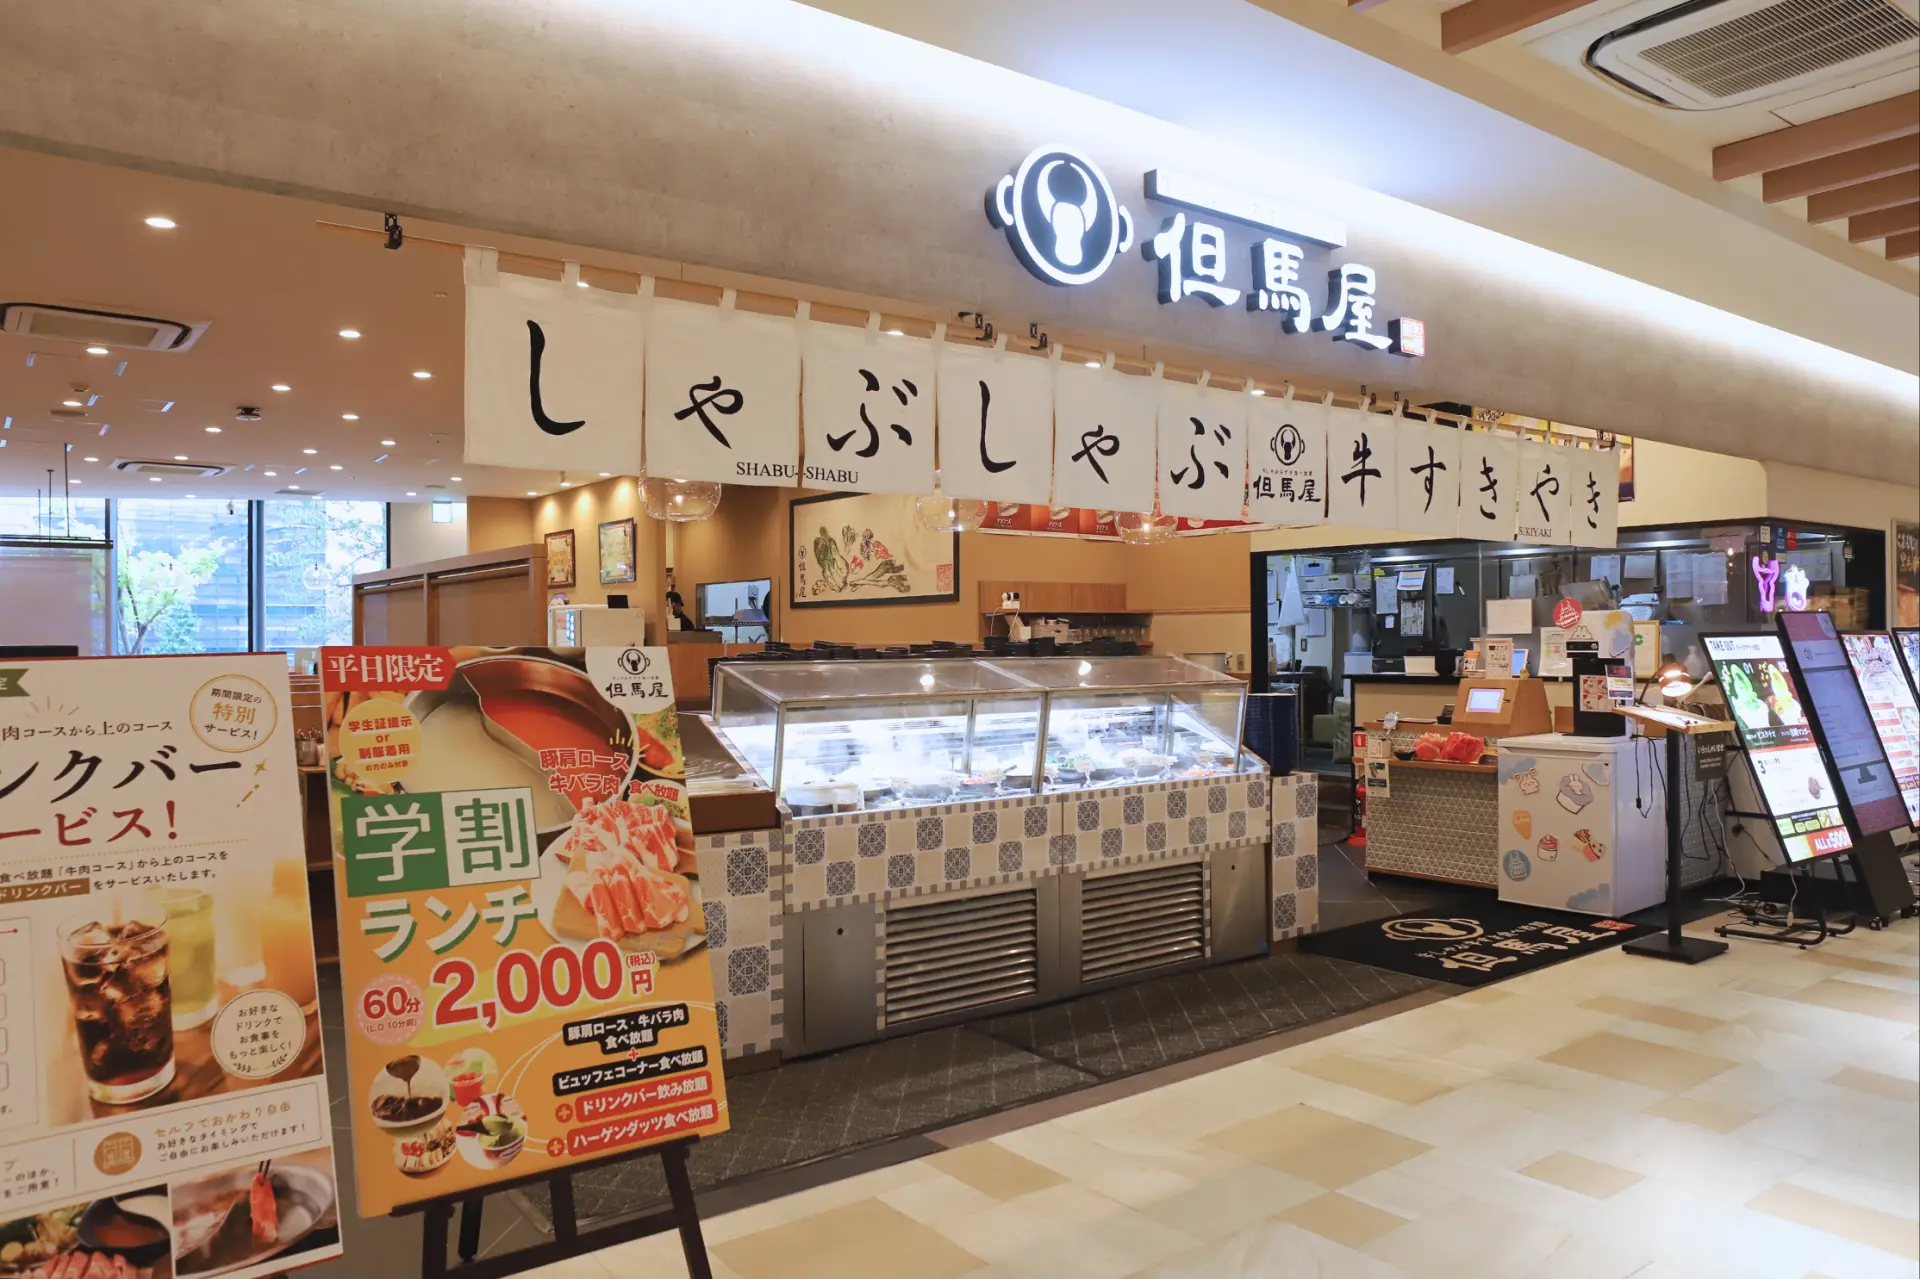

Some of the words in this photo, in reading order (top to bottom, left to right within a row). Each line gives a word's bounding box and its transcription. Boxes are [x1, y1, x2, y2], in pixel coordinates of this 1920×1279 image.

[1154, 213, 1392, 349] 但馬屋
[736, 461, 859, 484] SHABU-SHABU
[1253, 475, 1321, 502] 但馬屋
[1519, 527, 1552, 538] SKIYAKI
[327, 656, 444, 684] 平日限定
[210, 688, 262, 703] 期間限定の
[605, 682, 669, 698] 但馬屋
[212, 703, 256, 725] 特別
[348, 716, 412, 732] 学生証提示
[204, 724, 257, 740] サービス!
[376, 734, 389, 743] or
[359, 744, 410, 759] 制服着用
[540, 749, 629, 772] 豚肩ロース
[365, 760, 408, 771] の方のみ対象
[549, 774, 620, 794] 牛バラ肉
[629, 780, 680, 801] 食べ放題
[355, 797, 530, 882] 学割
[361, 885, 538, 962] ランチ
[1440, 926, 1617, 971] 但馬屋
[238, 1004, 278, 1017] お好きな
[236, 1016, 282, 1031] ドリンクで
[568, 1008, 684, 1041] 豚肩ロース・牛バラ肉
[240, 1030, 279, 1044] お食事を
[605, 1029, 653, 1049] 食べ放題
[558, 1050, 703, 1090] ビュッフェコーナー食べ放題
[583, 1076, 707, 1115] ドリンクバー飲み放題
[154, 1102, 291, 1137] セルフでおかわり自由
[573, 1104, 714, 1149] ハーゲンダッツ食べ放題
[157, 1122, 258, 1151] お好きなタイミングで
